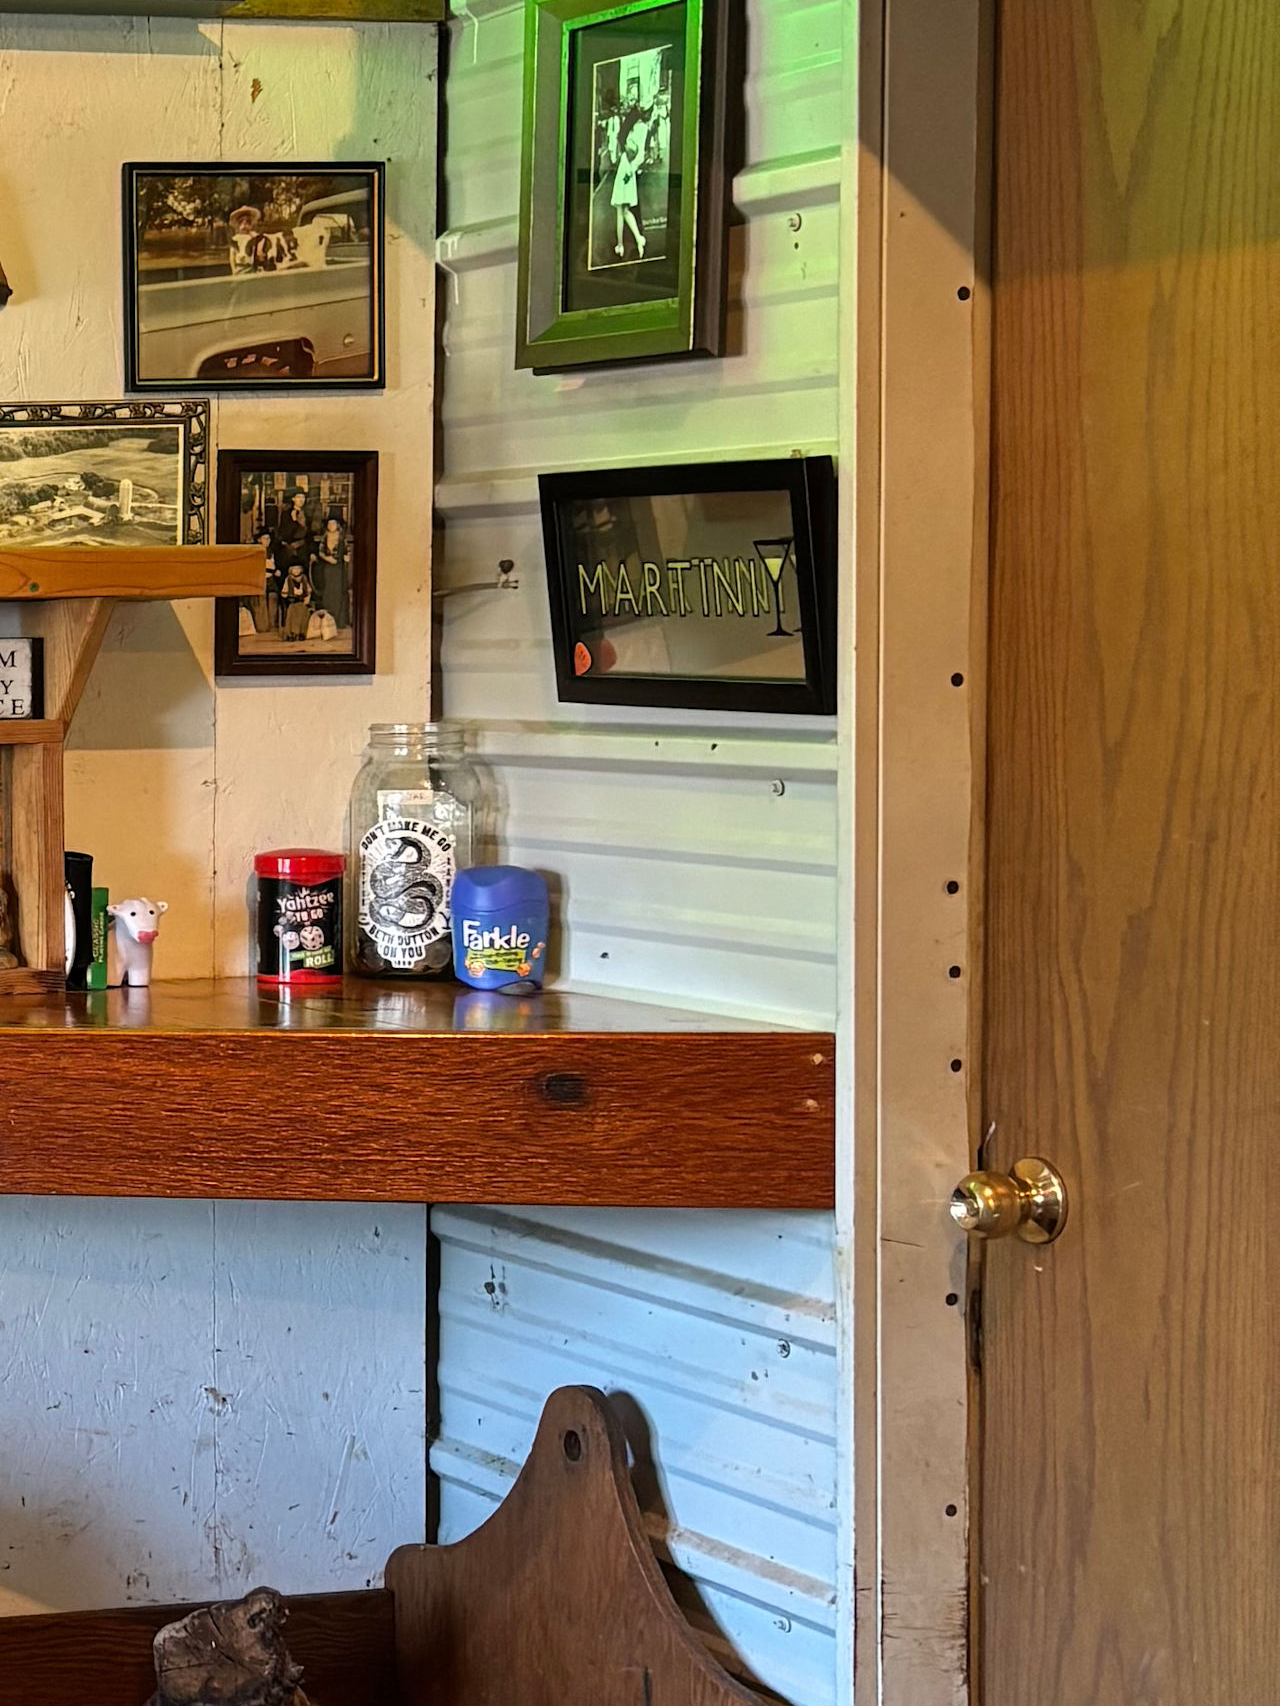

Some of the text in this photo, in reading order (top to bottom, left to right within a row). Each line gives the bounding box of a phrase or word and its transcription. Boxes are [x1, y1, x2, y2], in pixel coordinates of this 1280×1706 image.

[361, 826, 385, 850] DON'T
[421, 826, 437, 840] ME
[437, 837, 451, 852] GO
[276, 892, 334, 913] Yahtzee
[368, 924, 439, 945] BETH DUTTON
[462, 919, 531, 951] Farkle
[305, 953, 333, 967] ROLL
[401, 946, 422, 958] YOU
